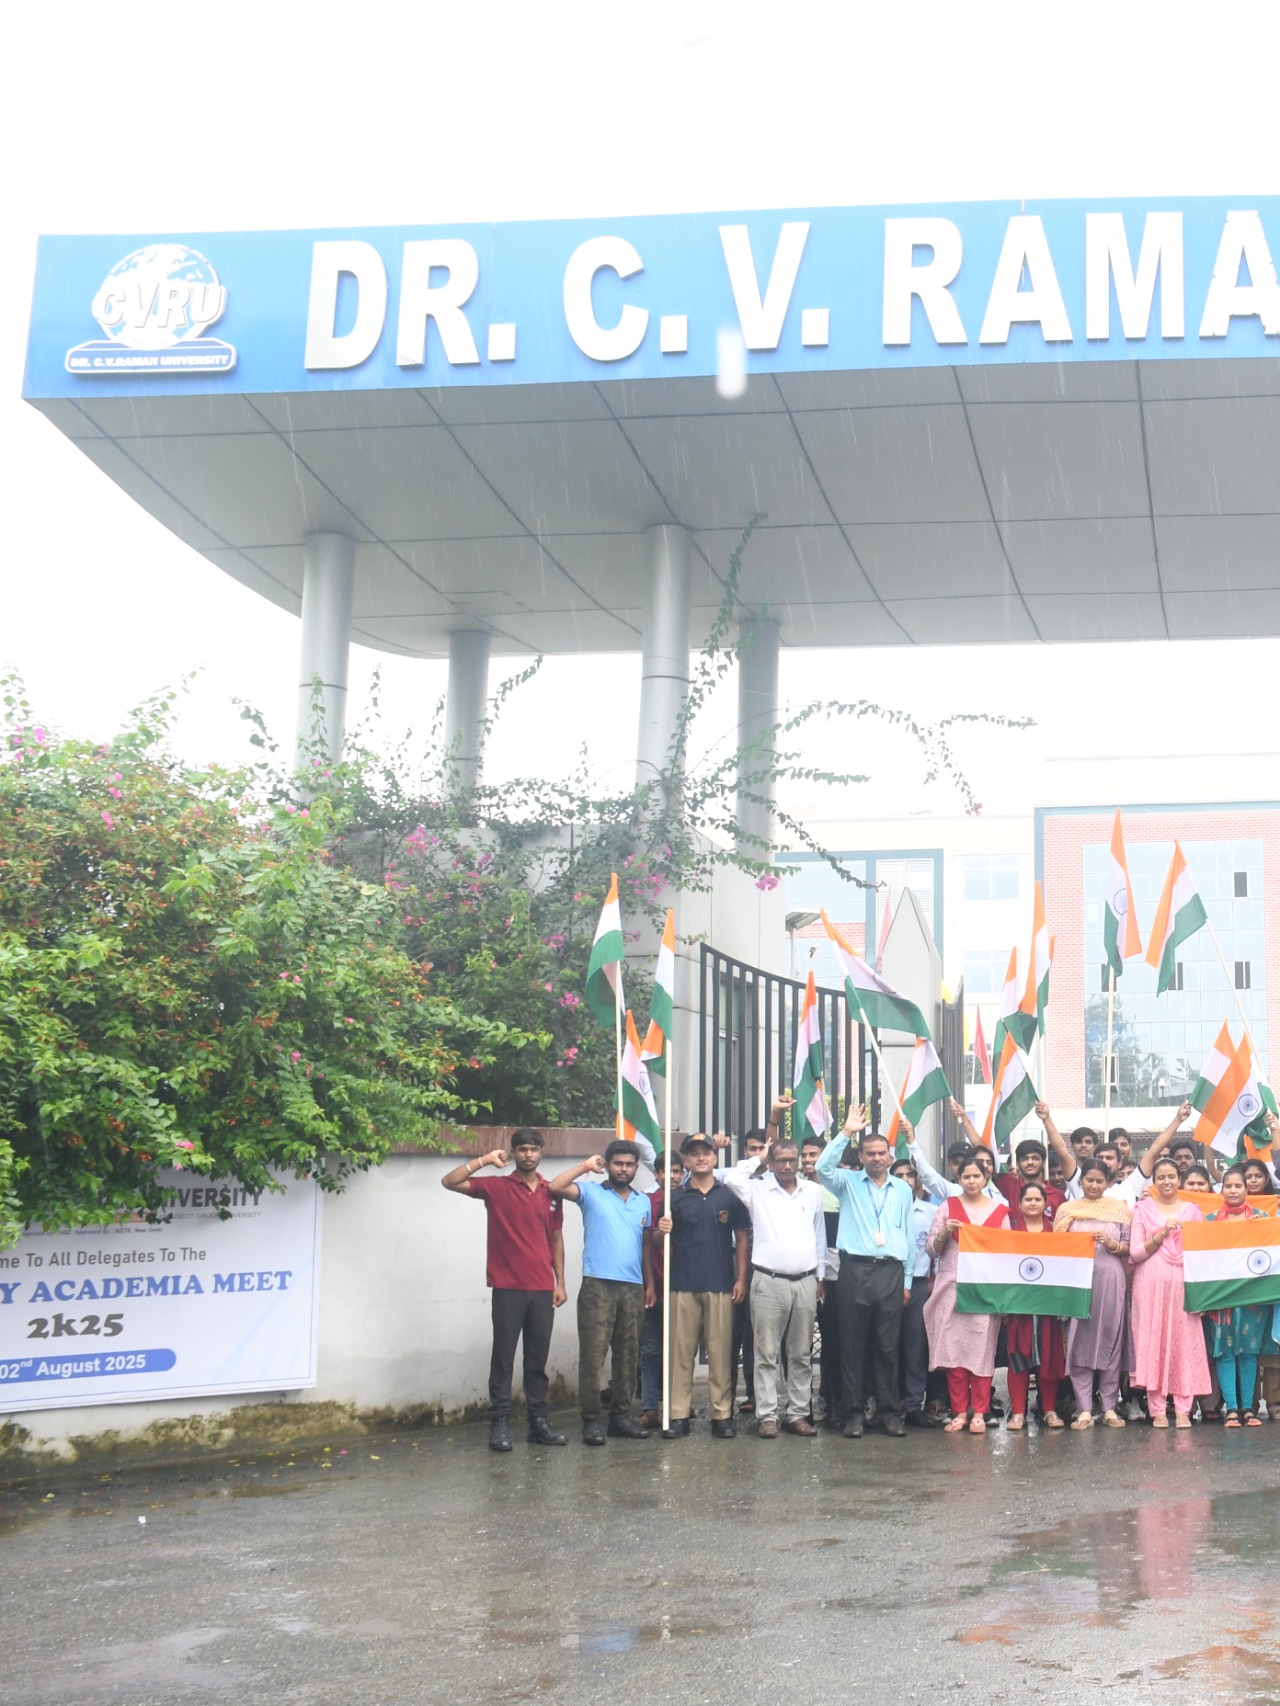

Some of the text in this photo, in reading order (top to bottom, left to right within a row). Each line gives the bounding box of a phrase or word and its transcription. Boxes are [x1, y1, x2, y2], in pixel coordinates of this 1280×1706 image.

[97, 281, 224, 330] CVRU
[304, 238, 516, 370] DR.
[562, 235, 688, 362] C.
[718, 221, 829, 351] V.
[70, 357, 91, 368] DR.
[160, 355, 229, 366] UNIVERSITY
[26, 1253, 43, 1268] To
[49, 1251, 71, 1267] All
[77, 1249, 155, 1268] Delegates
[160, 1248, 176, 1262] To
[180, 1247, 207, 1262] The
[28, 1274, 205, 1303] ACADEMIA
[212, 1270, 293, 1294] MEET
[27, 1313, 125, 1339] 2k25
[36, 1356, 101, 1379] August
[104, 1354, 147, 1372] 2025
